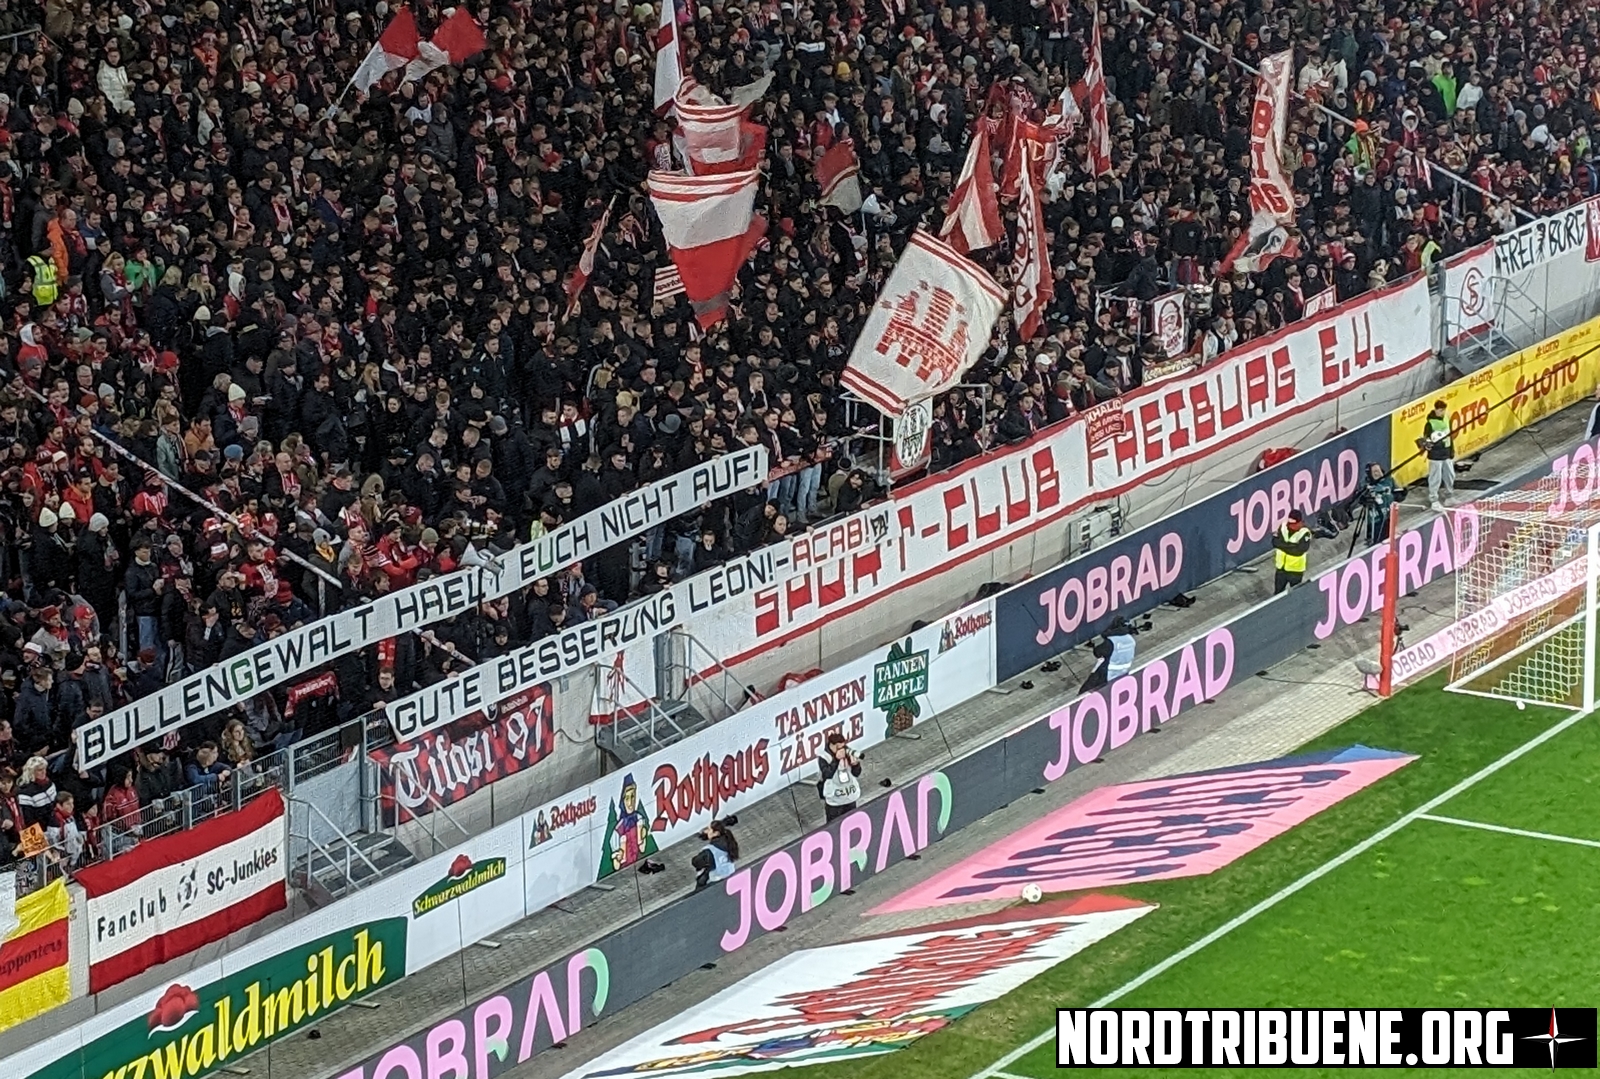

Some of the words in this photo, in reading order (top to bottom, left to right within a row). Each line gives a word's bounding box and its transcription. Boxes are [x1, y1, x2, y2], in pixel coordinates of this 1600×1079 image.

[1450, 396, 1489, 440] OTTO
[1533, 354, 1580, 400] LOTTO
[1226, 449, 1359, 554] JOBRAD
[83, 606, 374, 763] BULLENGEWALT
[520, 520, 589, 582] EUCH
[602, 480, 678, 541] NICHT
[692, 451, 760, 498] AUF!
[1036, 532, 1184, 646] JOBRAD
[1313, 503, 1480, 640] JOBRAD
[394, 673, 481, 736] GUTE
[499, 591, 675, 694] BESSERUNG
[955, 608, 993, 645] Rothaus
[1391, 642, 1436, 680] OBRAD
[775, 674, 867, 741] TANNEN
[876, 655, 927, 682] TANNEN
[877, 673, 925, 702] ZÄPFLE
[1042, 627, 1235, 782] JOBRAD
[550, 795, 597, 832] Rothaus
[652, 737, 770, 834] Rothaus
[97, 889, 168, 942] Fanclub
[206, 845, 278, 895] SC-Junkies
[414, 859, 505, 915] Schwarzwaldmilch
[335, 947, 610, 1079] BRAD
